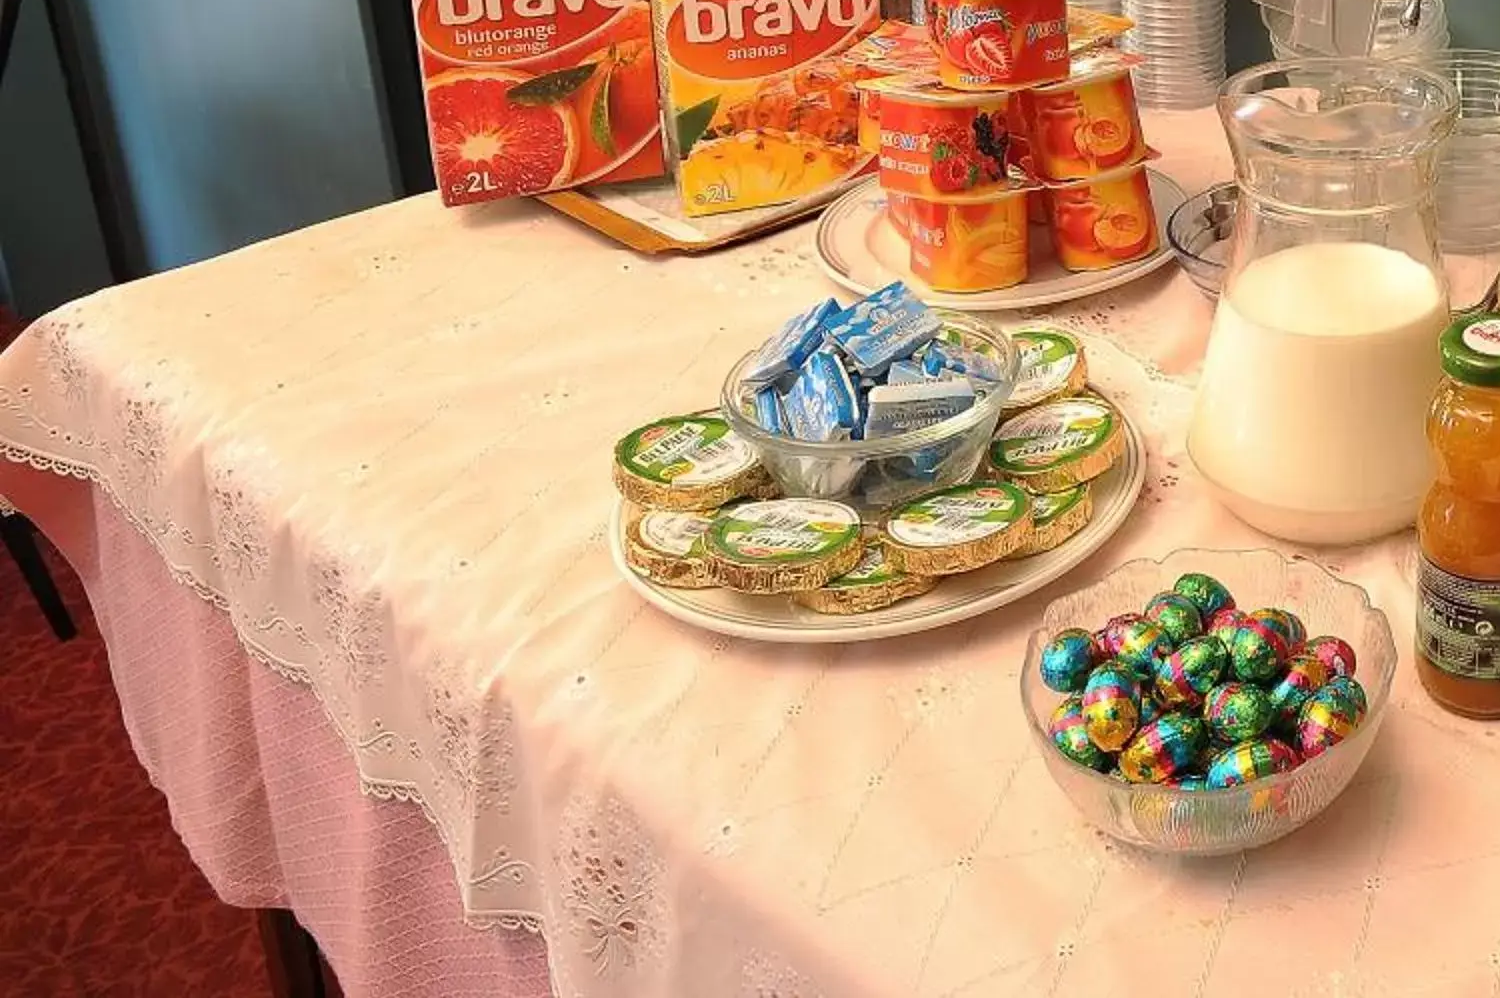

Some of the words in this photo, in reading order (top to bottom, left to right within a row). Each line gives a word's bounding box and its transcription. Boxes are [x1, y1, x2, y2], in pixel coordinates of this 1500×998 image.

[455, 23, 557, 46] blutorange
[467, 43, 493, 58] red
[497, 41, 550, 56] orange
[726, 43, 788, 61] ananas
[466, 171, 498, 193] 2L
[705, 185, 735, 203] 2L
